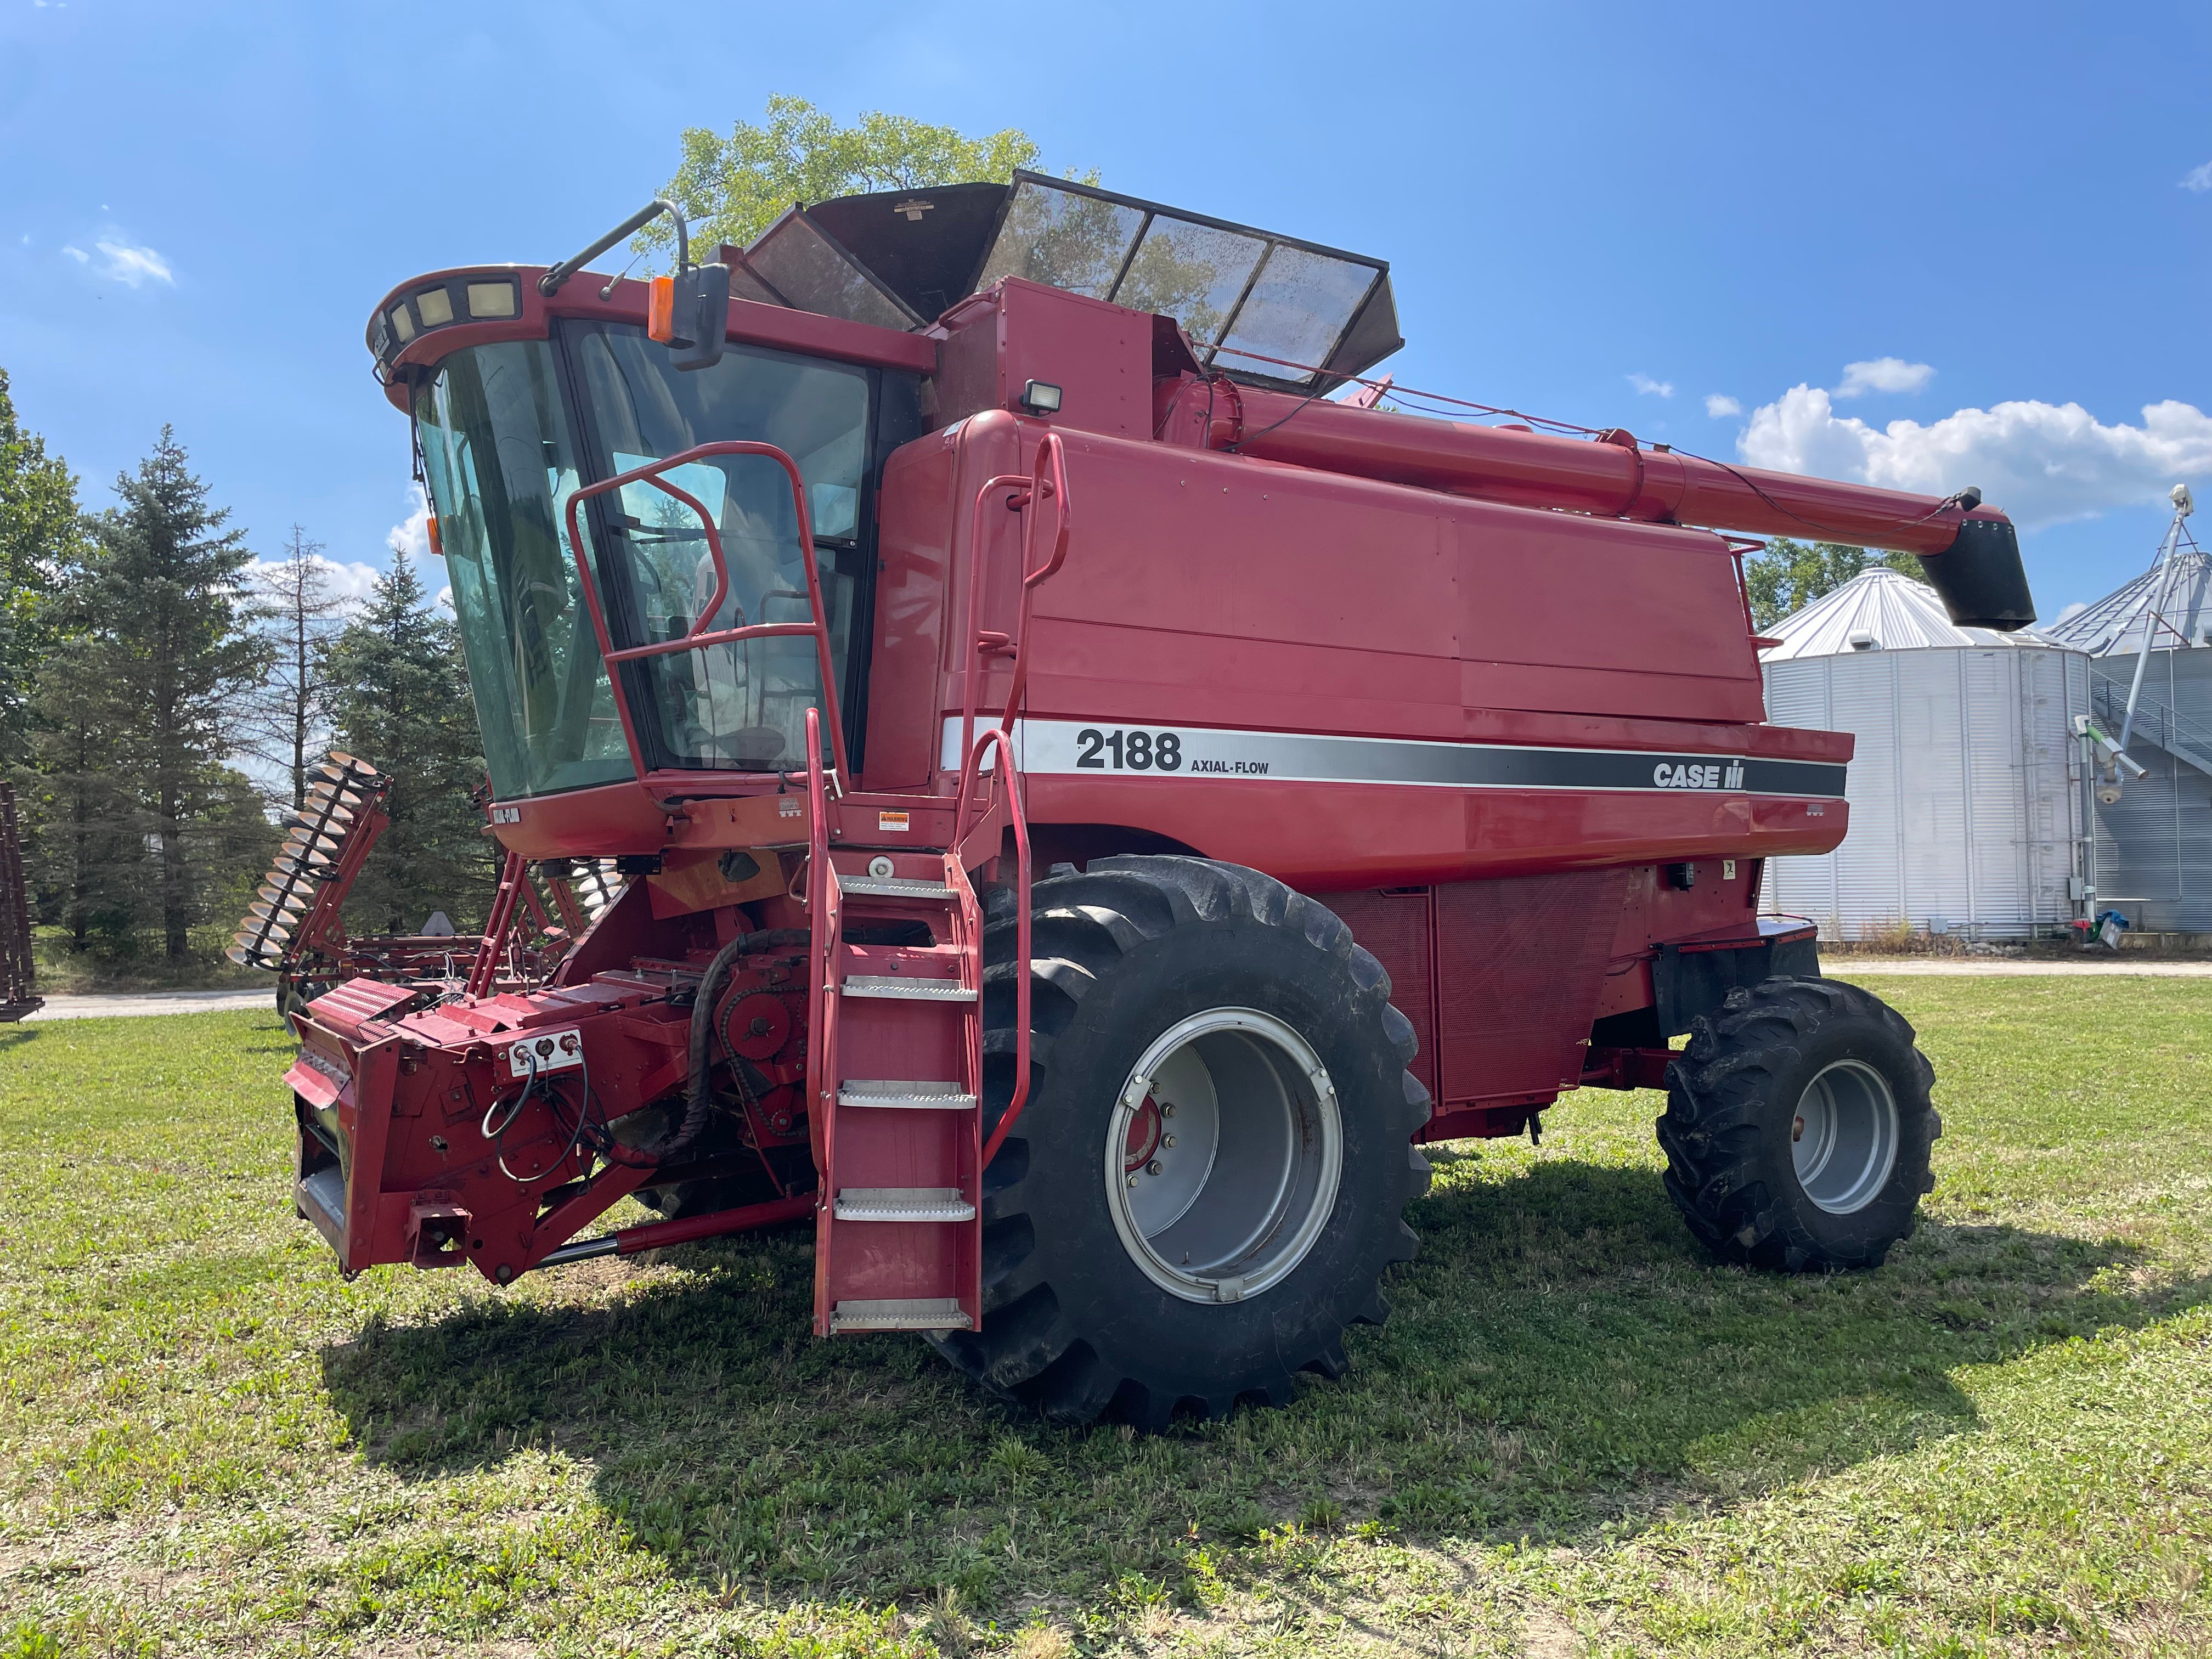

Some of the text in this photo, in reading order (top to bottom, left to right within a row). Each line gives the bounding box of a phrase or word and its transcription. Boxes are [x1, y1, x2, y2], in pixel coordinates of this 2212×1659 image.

[1076, 729, 1269, 774] 2188 AXIAL-FLOW
[1653, 763, 1720, 788] CASE
